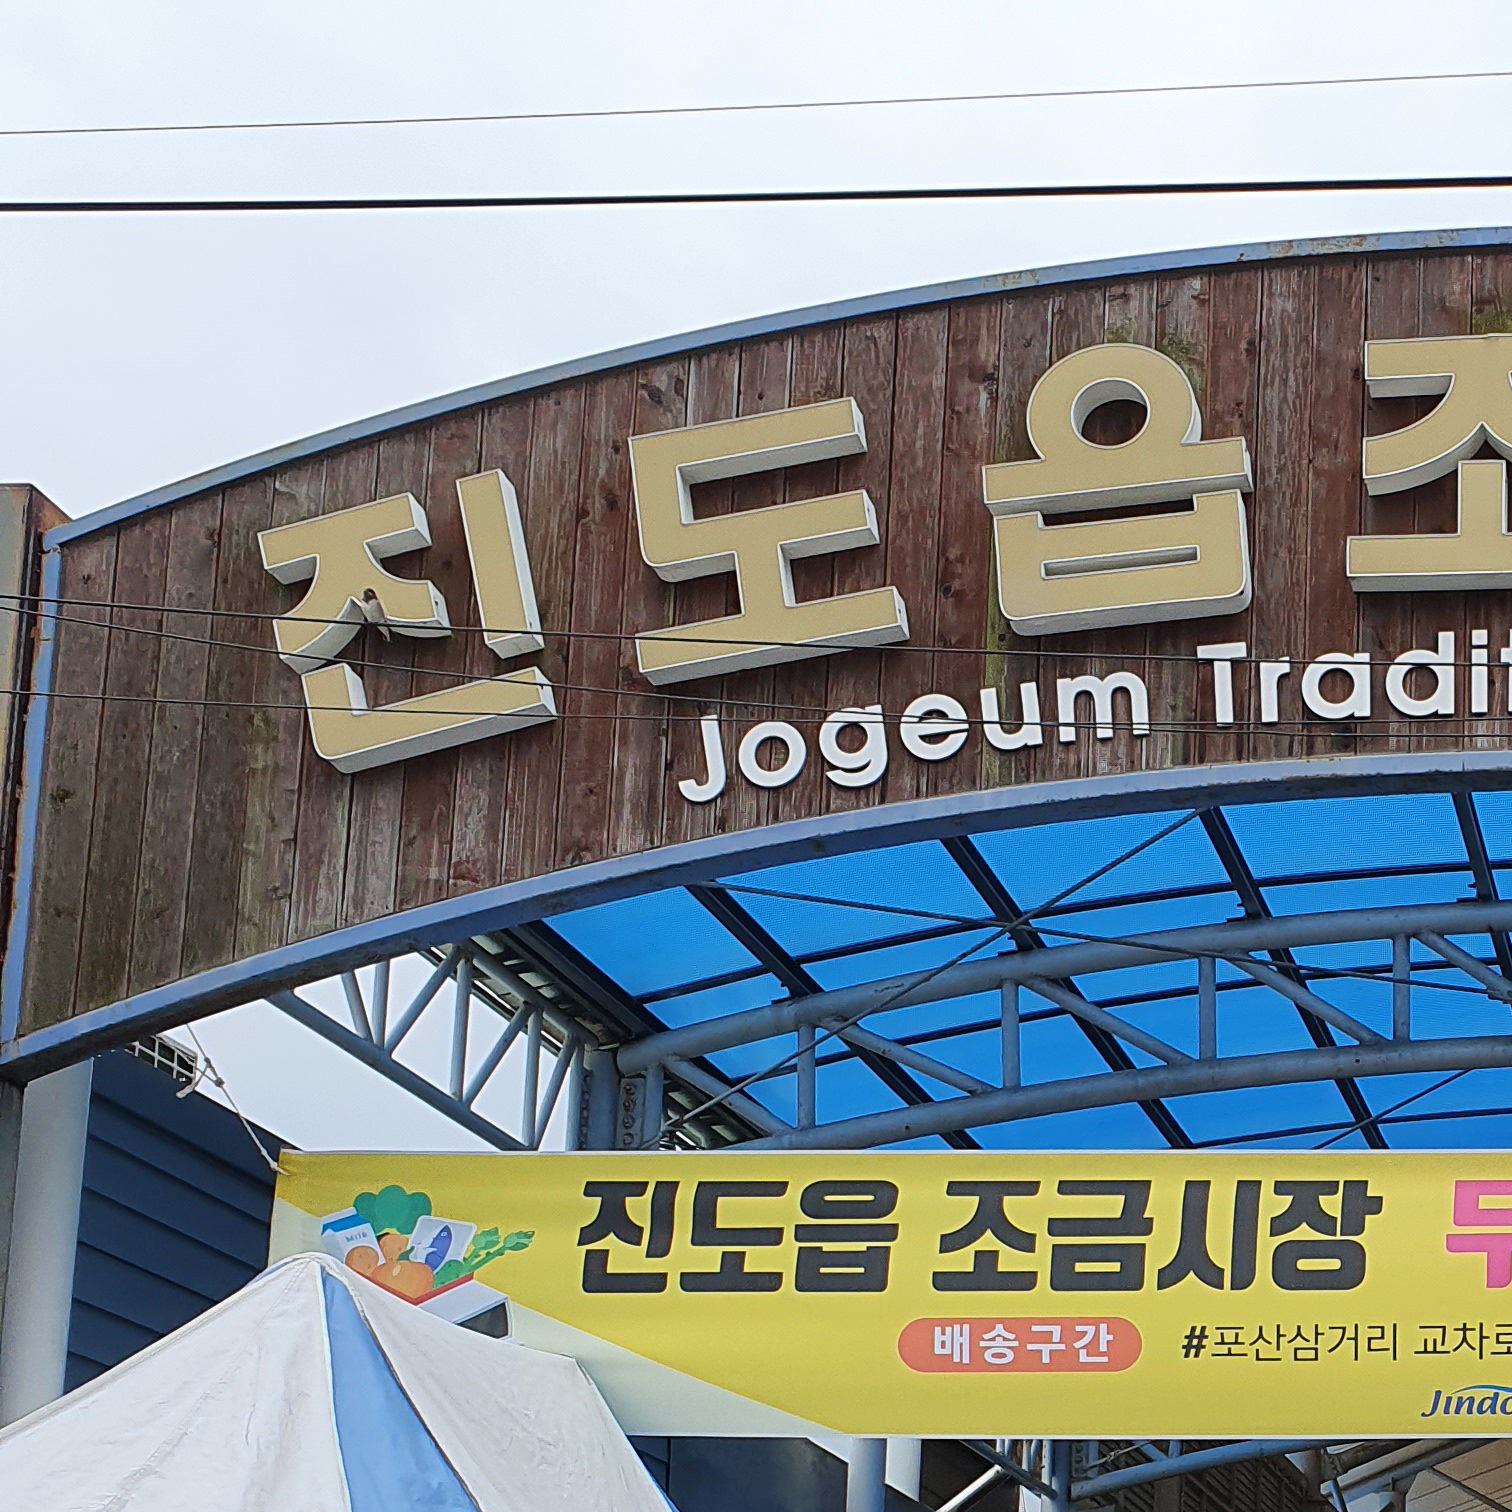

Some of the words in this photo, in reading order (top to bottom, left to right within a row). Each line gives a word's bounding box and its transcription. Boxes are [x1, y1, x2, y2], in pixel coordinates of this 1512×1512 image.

[678, 670, 1150, 803] Jogeum
[577, 1179, 899, 1293] 진도읍
[931, 1178, 1383, 1291] 조금시장
[933, 1322, 1115, 1366] 배송구간
[1181, 1320, 1400, 1363] #포산삼거리
